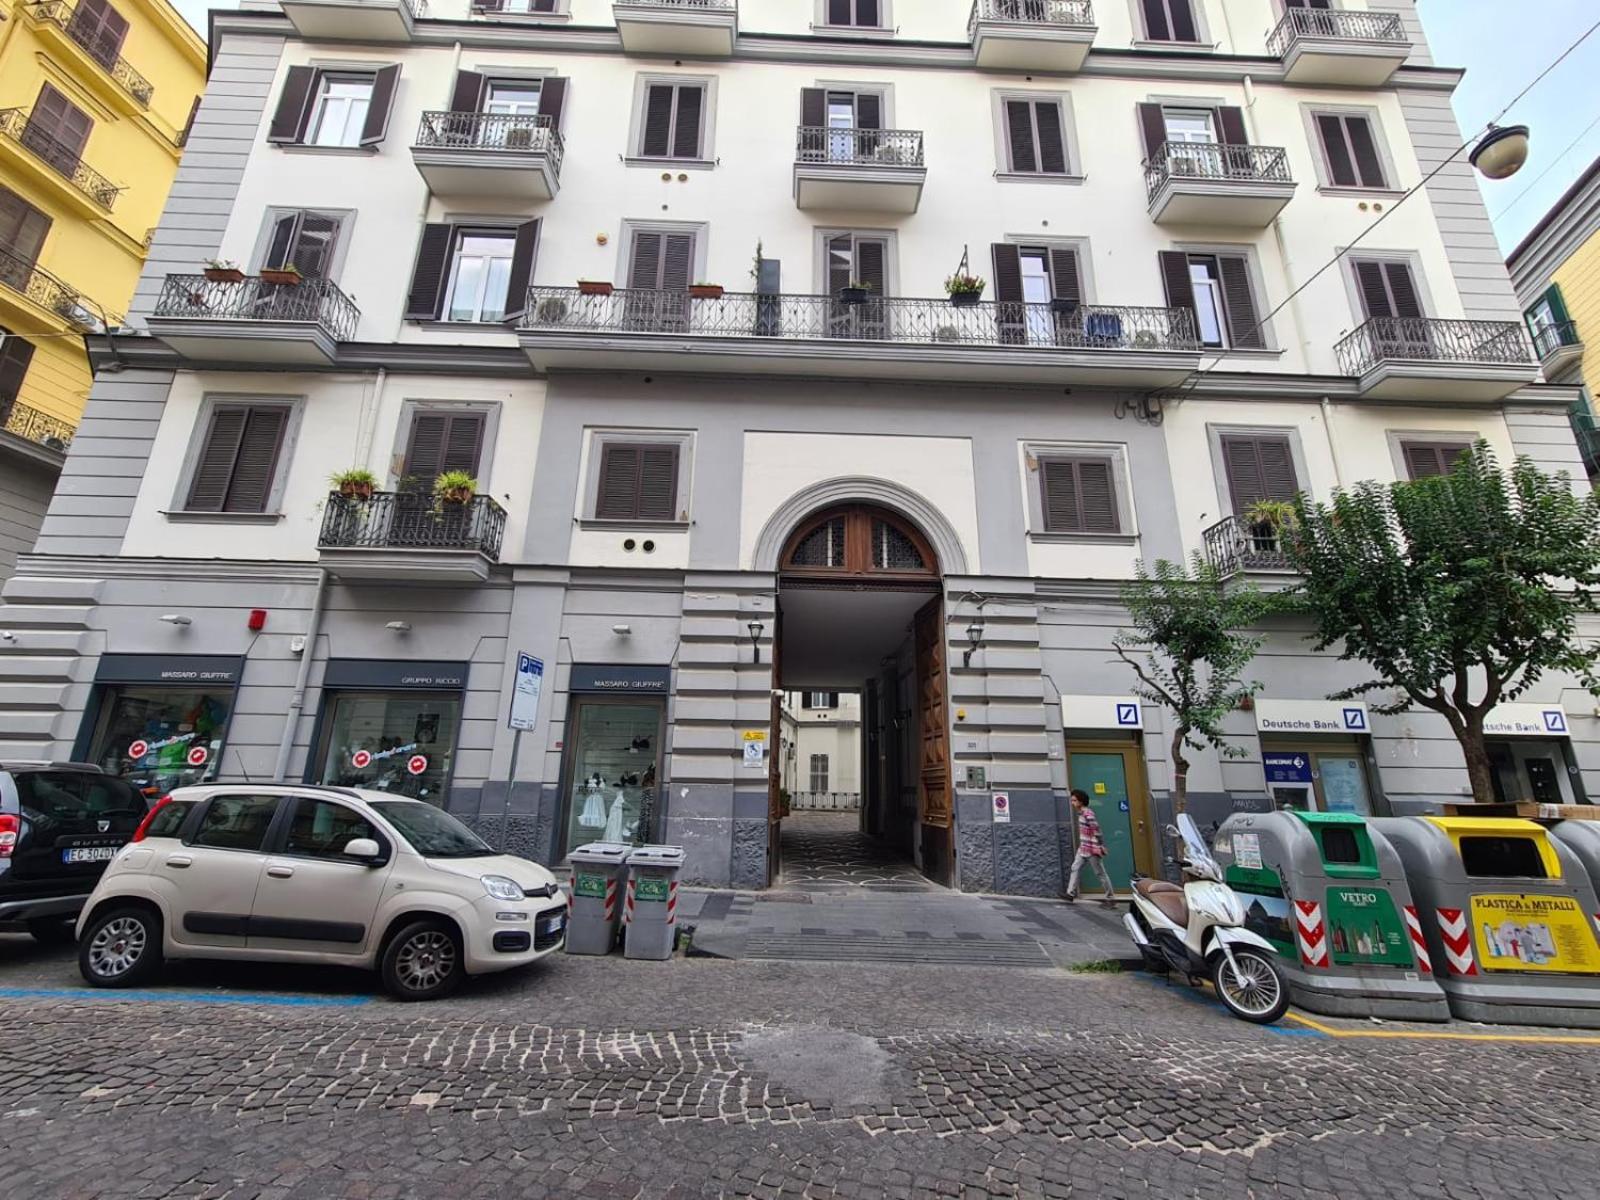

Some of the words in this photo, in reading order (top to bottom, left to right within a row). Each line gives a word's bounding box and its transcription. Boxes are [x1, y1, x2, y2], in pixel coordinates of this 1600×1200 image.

[161, 671, 197, 679] MASSARO
[594, 680, 629, 688] MASSARO
[1263, 719, 1311, 729] Deutsche
[1313, 720, 1340, 729] Bank
[1515, 723, 1540, 731] Bank
[1339, 892, 1377, 903] VETRO
[1475, 899, 1522, 910] PLASTICA
[1532, 901, 1575, 911] METALLI
